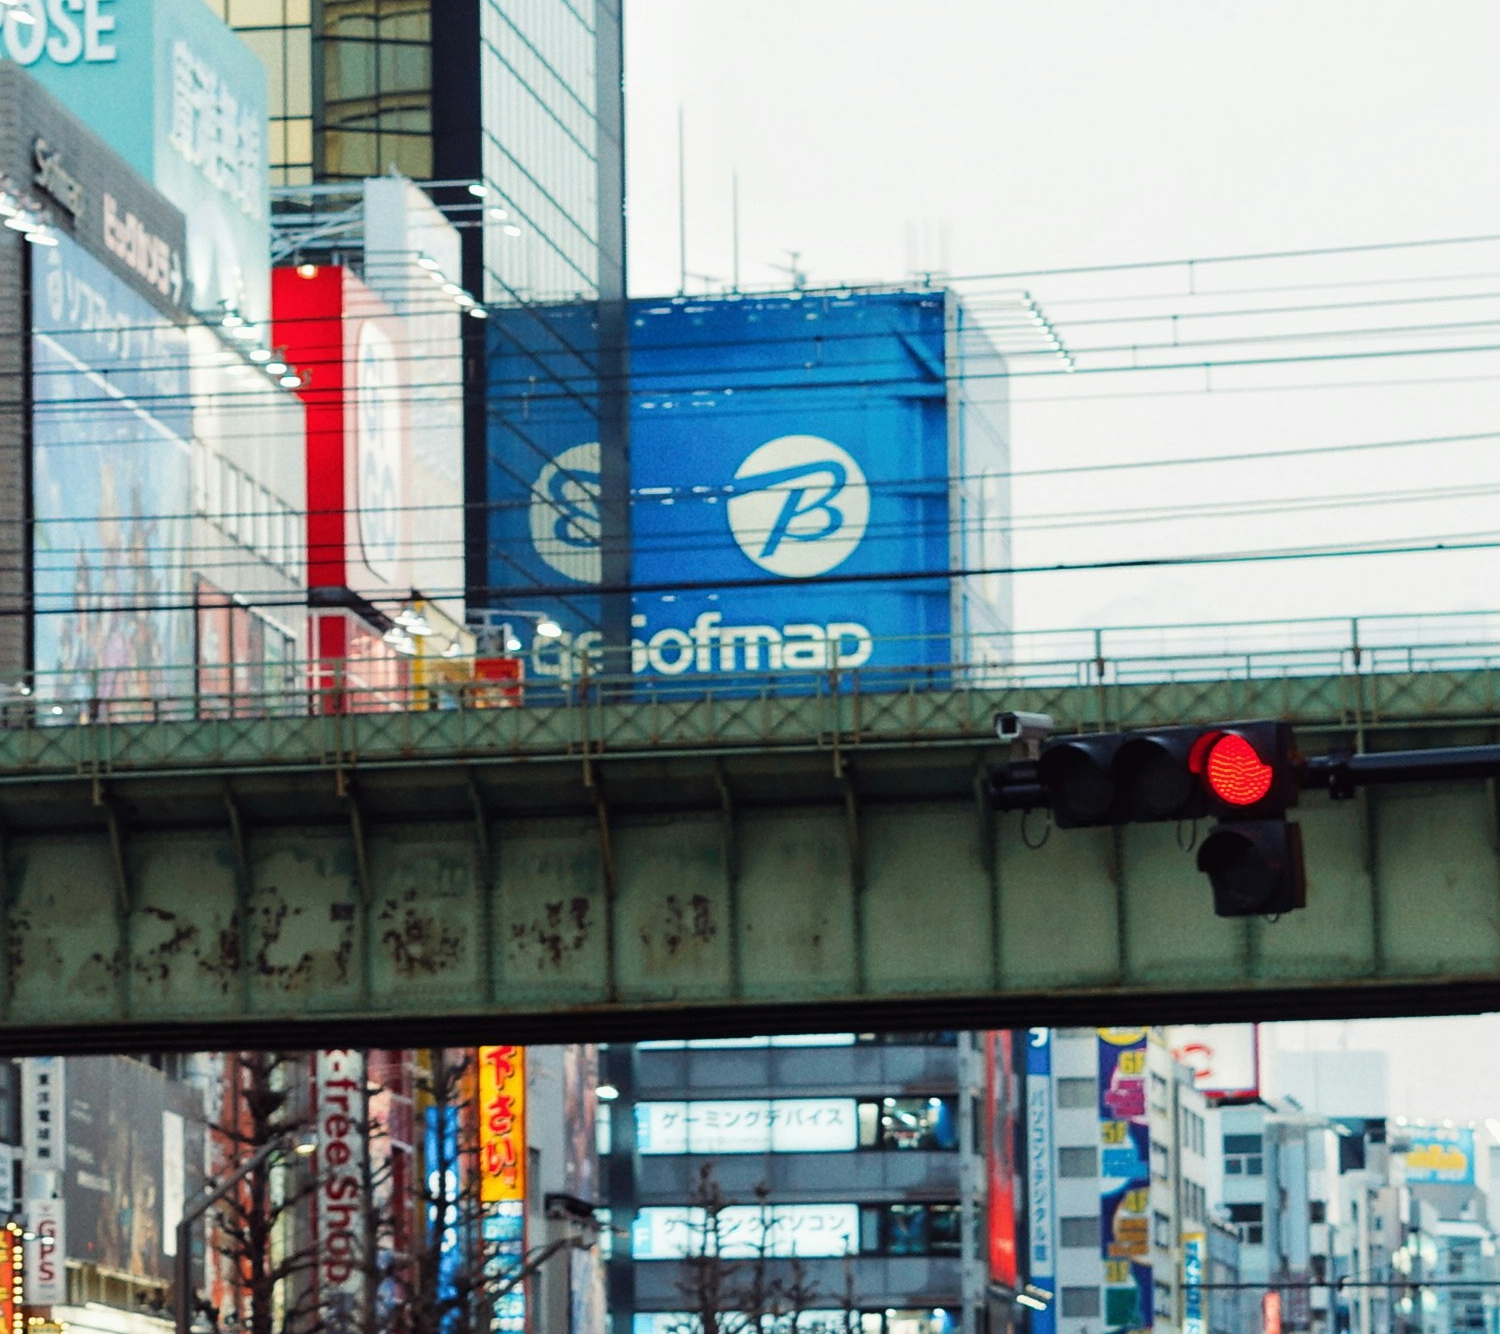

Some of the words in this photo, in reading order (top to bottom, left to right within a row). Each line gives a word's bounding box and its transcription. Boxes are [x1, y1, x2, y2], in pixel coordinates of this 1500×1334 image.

[661, 1107, 845, 1130] ゲーミングデバイス
[324, 1165, 351, 1285] Shop
